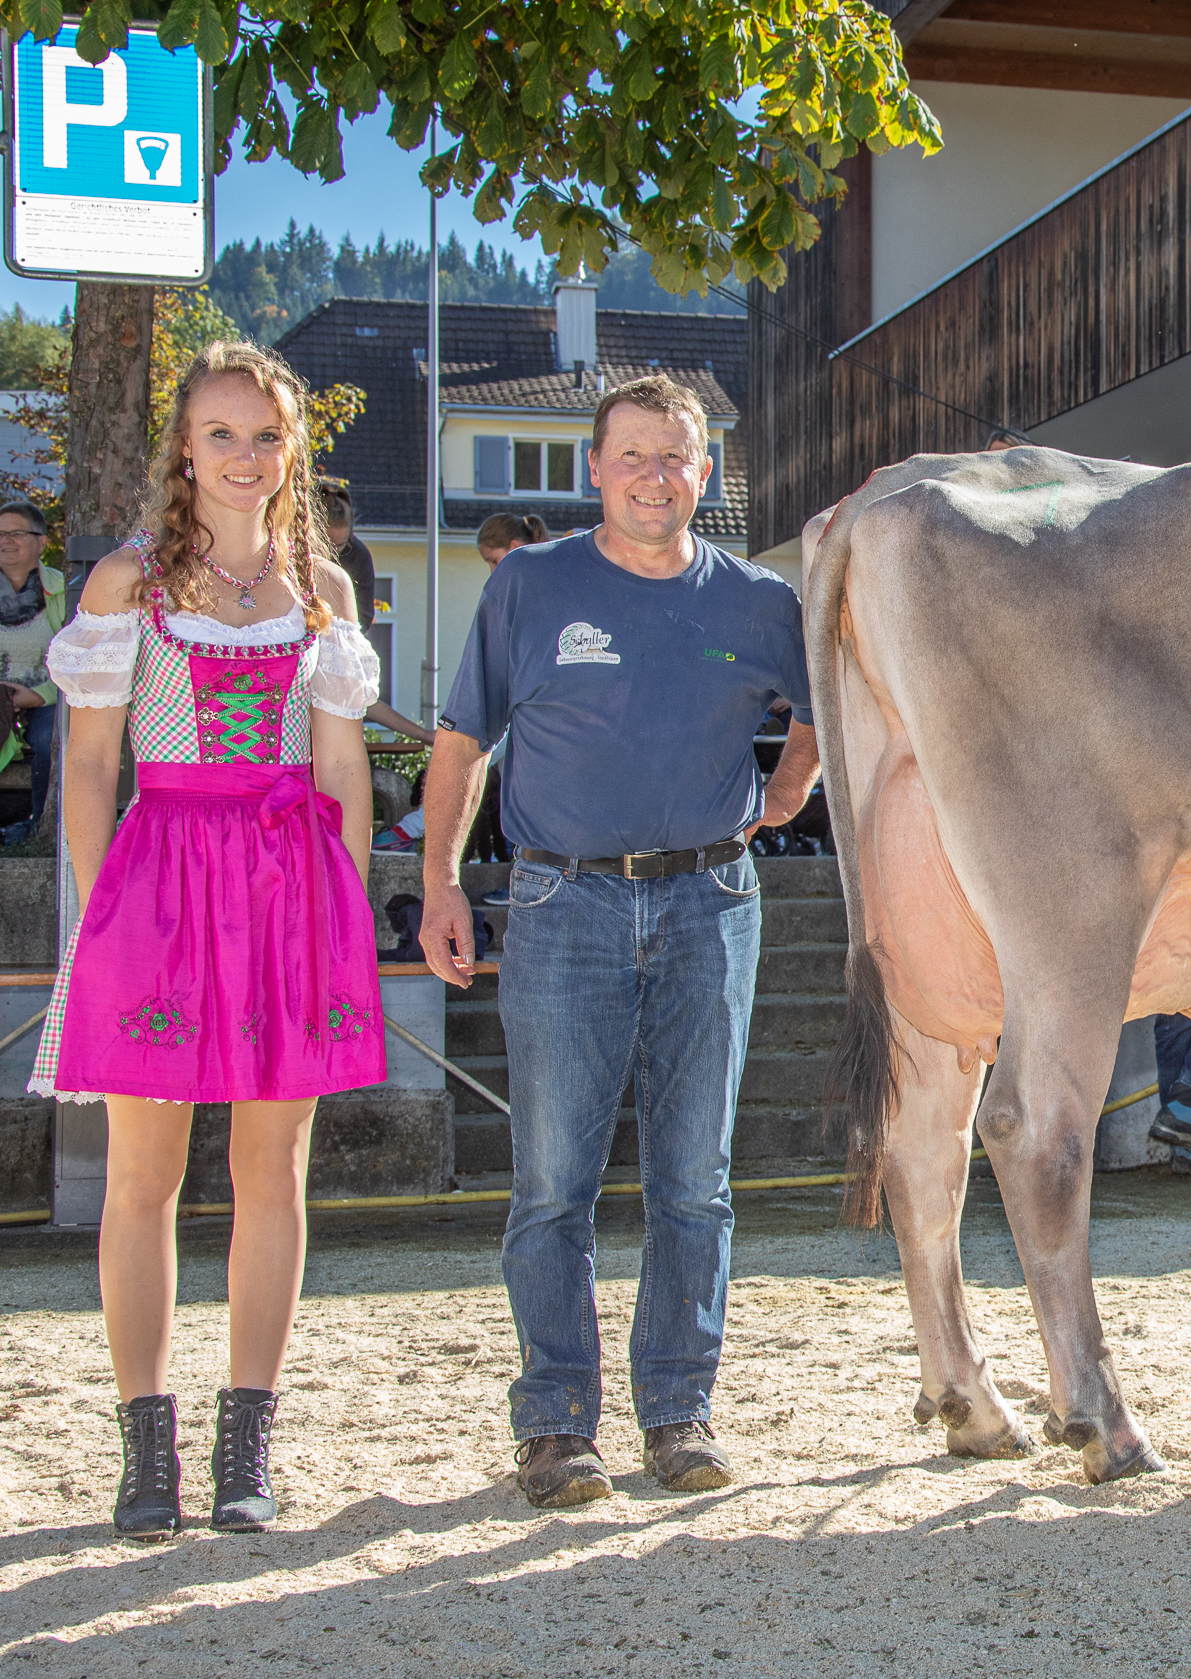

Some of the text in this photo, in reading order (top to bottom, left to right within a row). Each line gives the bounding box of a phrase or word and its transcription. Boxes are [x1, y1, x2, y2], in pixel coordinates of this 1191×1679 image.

[42, 45, 128, 169] P
[70, 202, 151, 214] Gerichtliches Verbot
[704, 648, 725, 659] UFA
